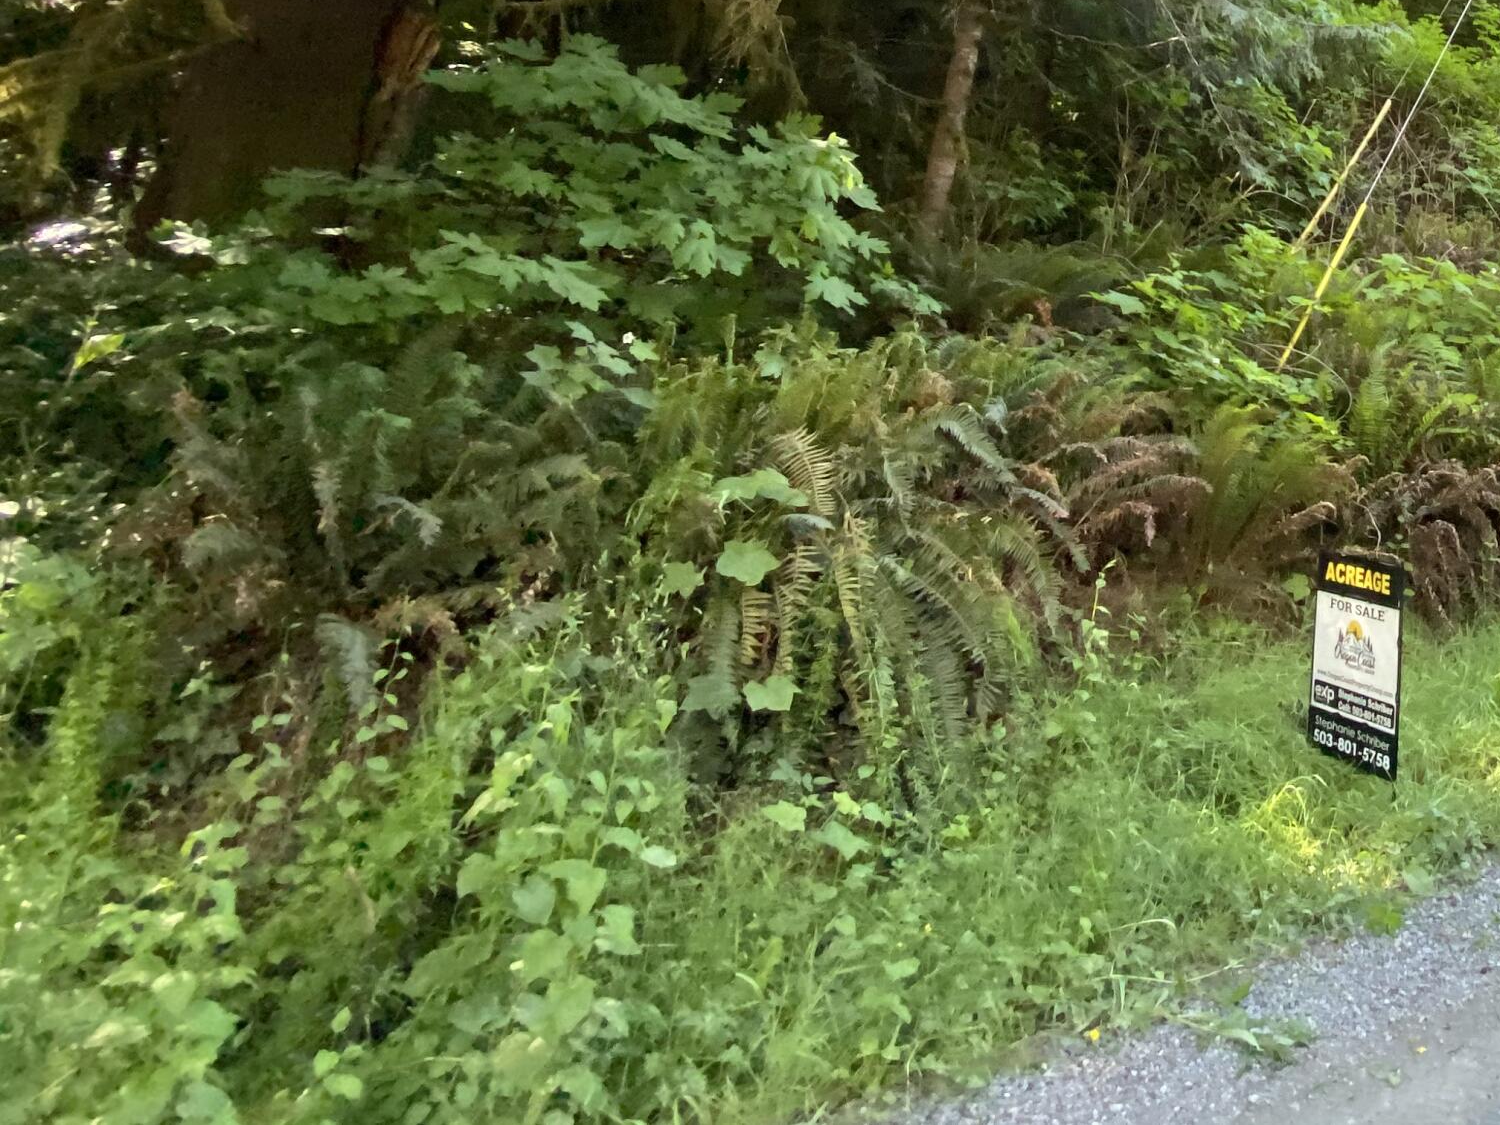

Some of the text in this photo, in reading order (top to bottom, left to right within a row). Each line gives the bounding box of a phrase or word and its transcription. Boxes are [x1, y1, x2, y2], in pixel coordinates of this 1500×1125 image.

[1325, 562, 1391, 595] ACREAGE
[1330, 597, 1385, 622] FOR SALE
[1313, 728, 1391, 770] 503-801-5758
[1315, 714, 1390, 752] Stephanie Schriber
